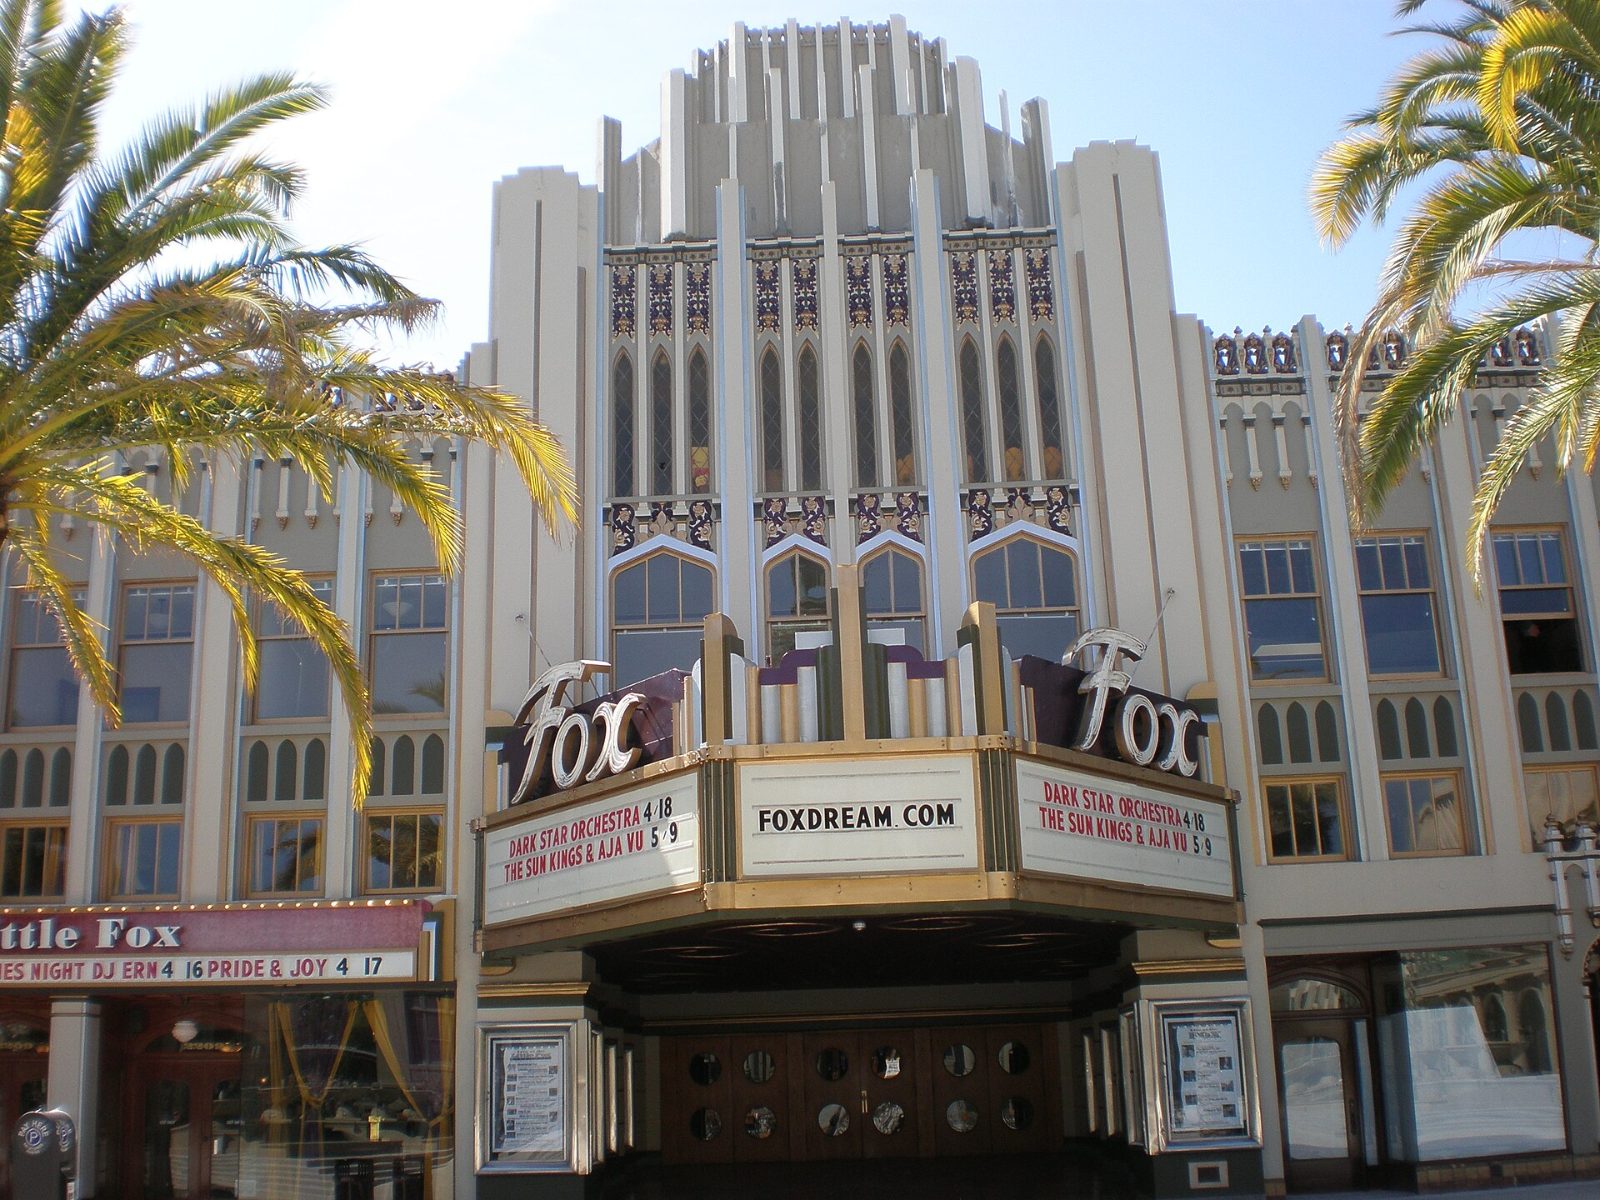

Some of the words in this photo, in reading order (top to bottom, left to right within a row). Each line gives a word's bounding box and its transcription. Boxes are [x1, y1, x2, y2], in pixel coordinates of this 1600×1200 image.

[1062, 628, 1199, 777] Fox
[511, 660, 647, 804] Fox
[509, 833, 537, 858] DARK
[540, 825, 568, 850] STAR
[570, 806, 640, 842] ORCHESTRA
[643, 796, 673, 822] 4/18
[759, 803, 954, 831] FOXDREAM.COM
[1039, 807, 1064, 831] THE
[1068, 812, 1093, 835] SUN
[1096, 818, 1133, 842] KINGS
[1136, 825, 1144, 844] &
[1149, 827, 1170, 849] AJA
[1173, 832, 1187, 851] VU
[1043, 781, 1079, 808] DARK
[1082, 789, 1115, 814] STAR
[1119, 796, 1182, 827] ORCHESTRA
[1183, 811, 1205, 832] 4/18
[504, 861, 523, 883] THE
[526, 854, 546, 878] SUN
[549, 844, 583, 872] KINGS
[586, 843, 594, 863] &
[598, 836, 623, 861] AJA
[627, 830, 644, 853] VU
[95, 919, 181, 948] Fox
[31, 962, 84, 980] NIGHT
[92, 962, 114, 979] DJ
[122, 961, 157, 979] ERN
[161, 961, 173, 978] 4
[186, 961, 203, 978] 16
[207, 959, 264, 977] PRIDE
[270, 960, 282, 977] &
[290, 958, 327, 977] JOY
[336, 958, 349, 975] 4
[364, 957, 383, 975] 17
